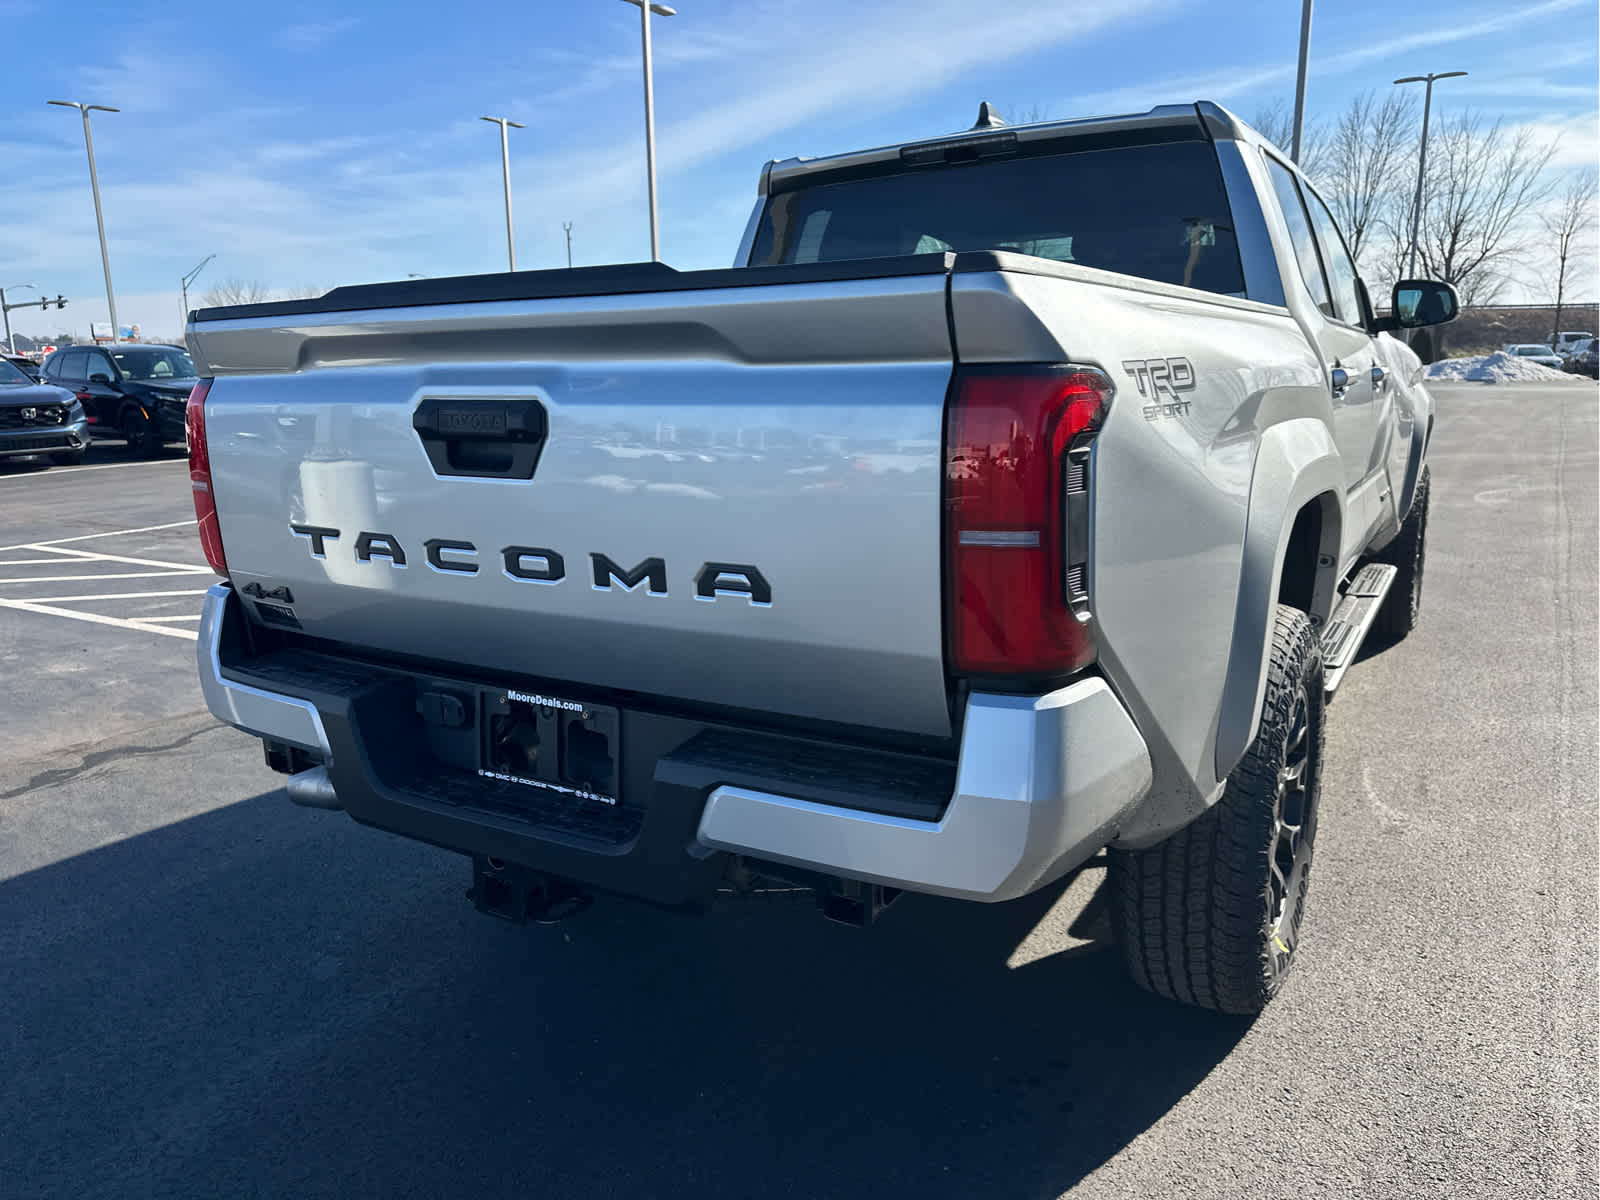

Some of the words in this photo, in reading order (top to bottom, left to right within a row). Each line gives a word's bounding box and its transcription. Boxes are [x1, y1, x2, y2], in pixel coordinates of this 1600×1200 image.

[1121, 357, 1196, 404] TRD
[1142, 401, 1192, 419] SPORT
[289, 524, 774, 608] TACOMA
[507, 690, 583, 712] MooreDeals.com
